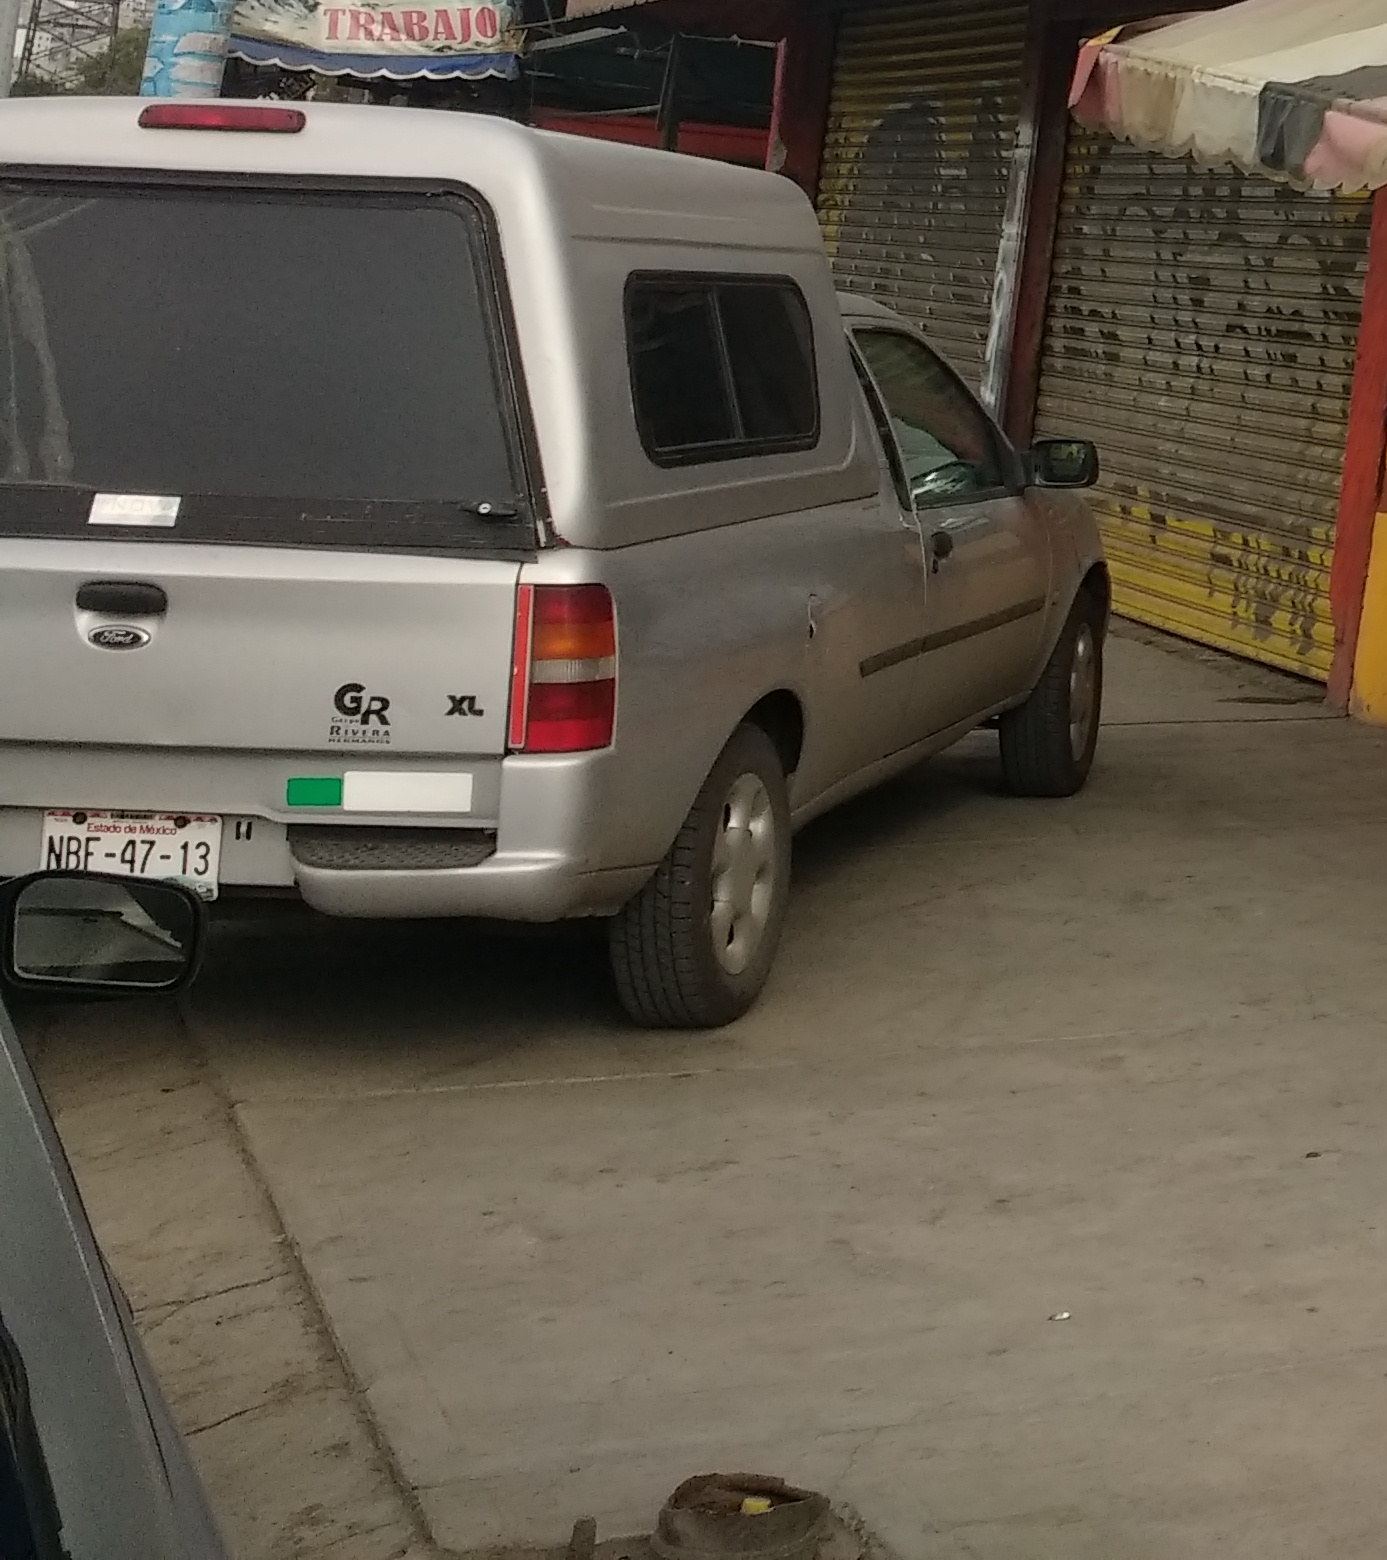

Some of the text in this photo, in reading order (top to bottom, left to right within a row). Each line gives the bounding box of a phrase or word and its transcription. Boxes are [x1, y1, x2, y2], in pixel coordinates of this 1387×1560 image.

[323, 6, 498, 45] TRABAJO
[99, 629, 135, 646] Ford
[334, 682, 391, 726] GR
[444, 694, 485, 717] XL
[86, 823, 122, 834] Estado
[124, 824, 136, 834] de
